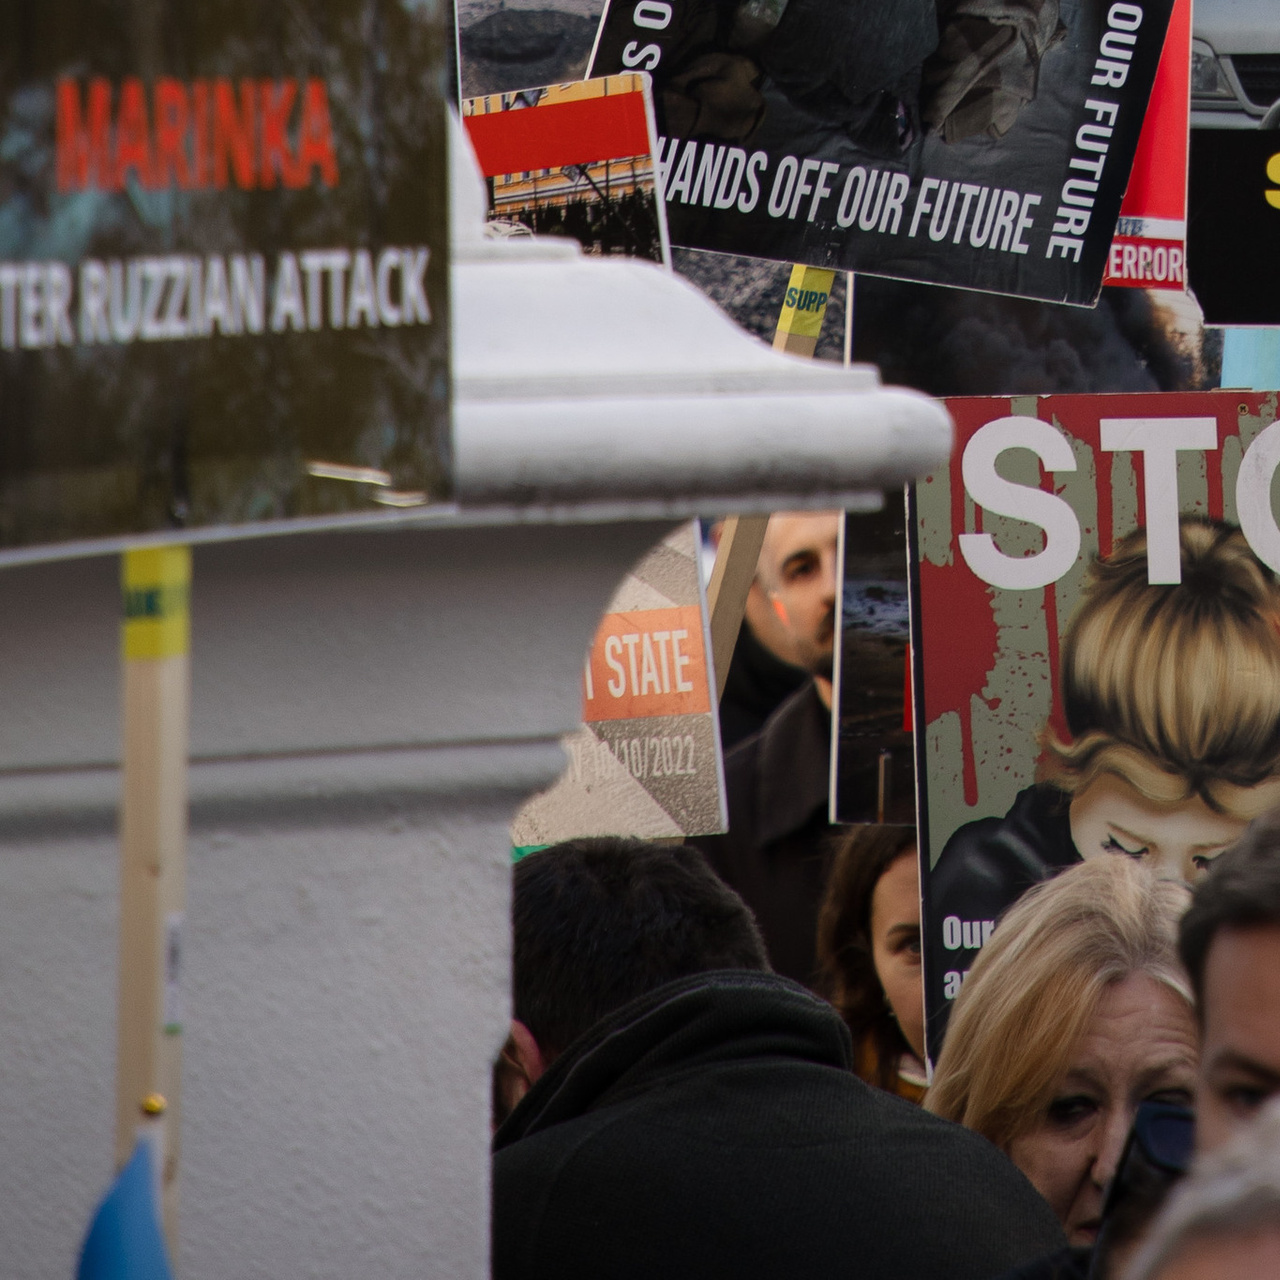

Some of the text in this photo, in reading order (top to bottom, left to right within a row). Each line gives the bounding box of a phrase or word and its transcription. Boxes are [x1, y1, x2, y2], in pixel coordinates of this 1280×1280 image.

[1090, 2, 1144, 89] OUR
[56, 78, 339, 192] MARINKA
[1045, 97, 1121, 264] FUTURE
[657, 137, 1042, 255] HANDS OFF OUR FUTURE
[78, 250, 266, 344] RUZZIAN
[269, 243, 432, 335] ATTACK
[604, 629, 694, 699] STATE
